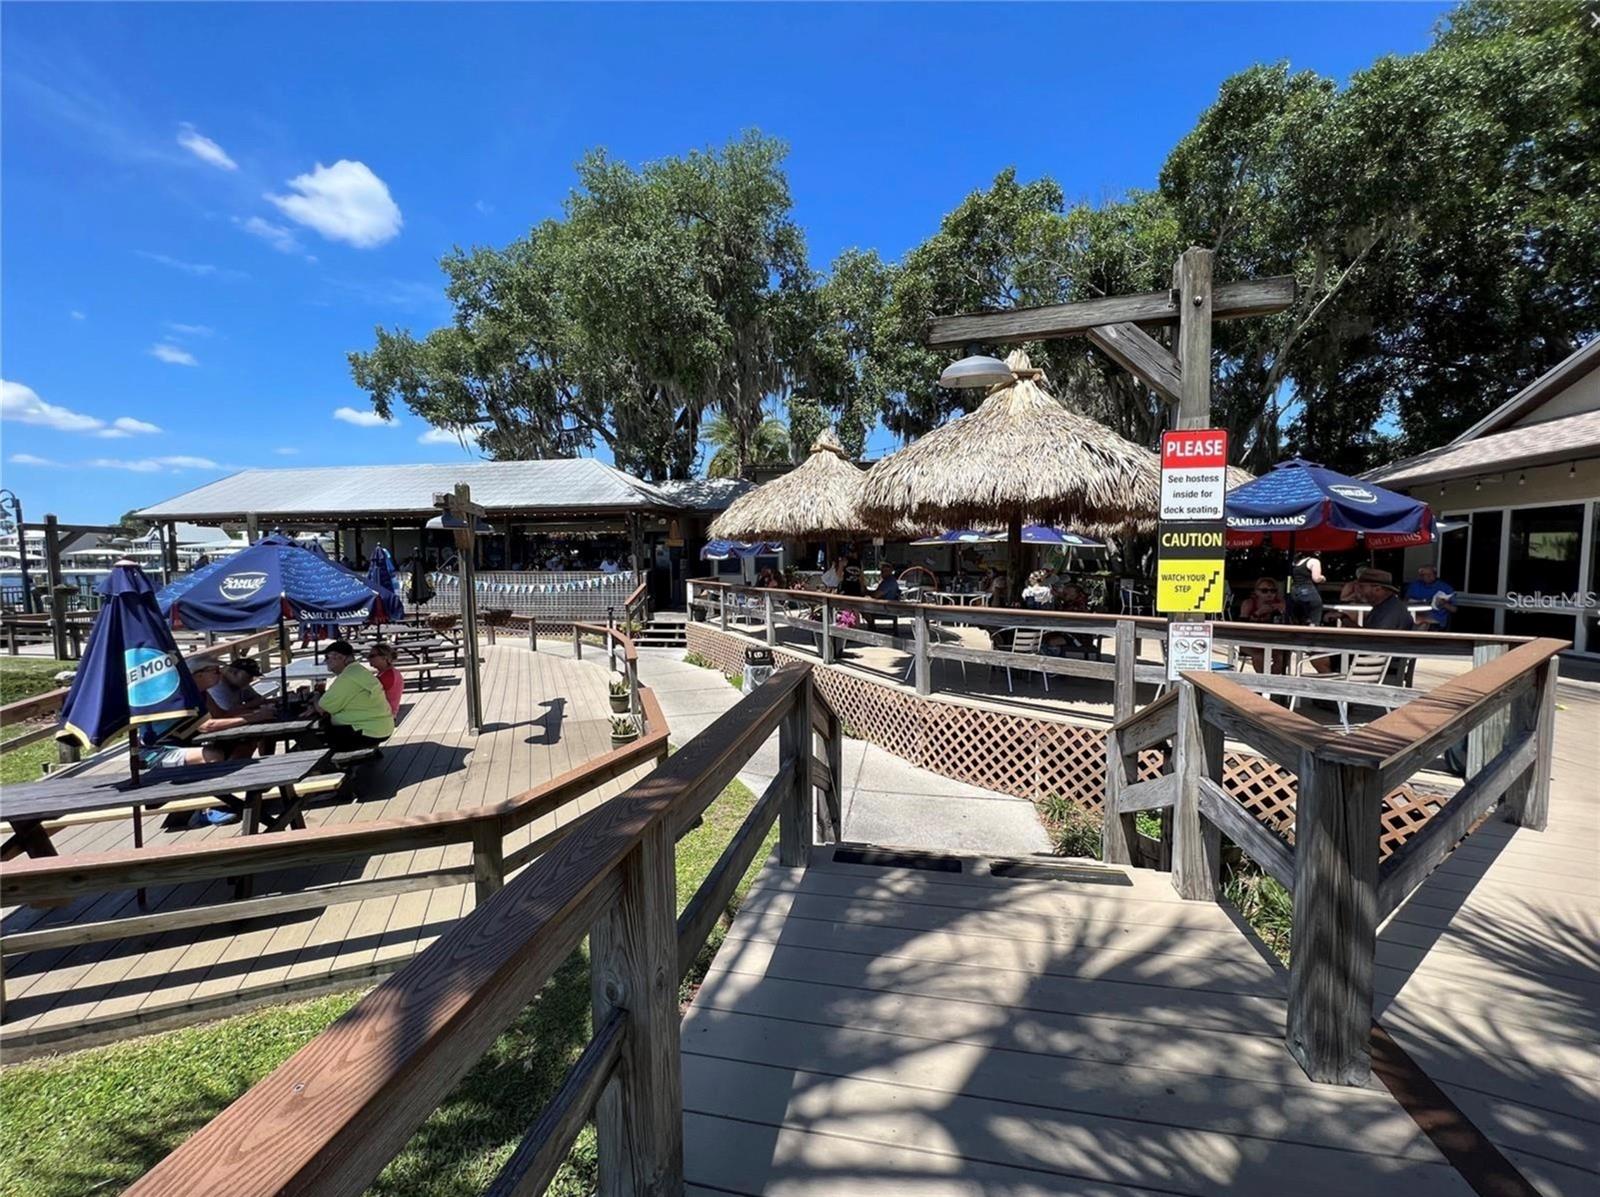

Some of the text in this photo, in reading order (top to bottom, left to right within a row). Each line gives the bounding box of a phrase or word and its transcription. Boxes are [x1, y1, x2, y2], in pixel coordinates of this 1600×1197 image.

[1166, 440, 1223, 457] PLEASE
[1168, 474, 1220, 483] See hostess
[1173, 489, 1214, 498] inside for
[1163, 505, 1221, 515] deck seating.
[1226, 514, 1307, 527] SAMUEL ADAMS
[1162, 532, 1222, 547] CAUTION
[1161, 574, 1206, 582] WATCH YOUR
[1174, 585, 1192, 593] STEP
[300, 607, 370, 620] SAMUEL ADAMS
[140, 657, 173, 678] MOO
